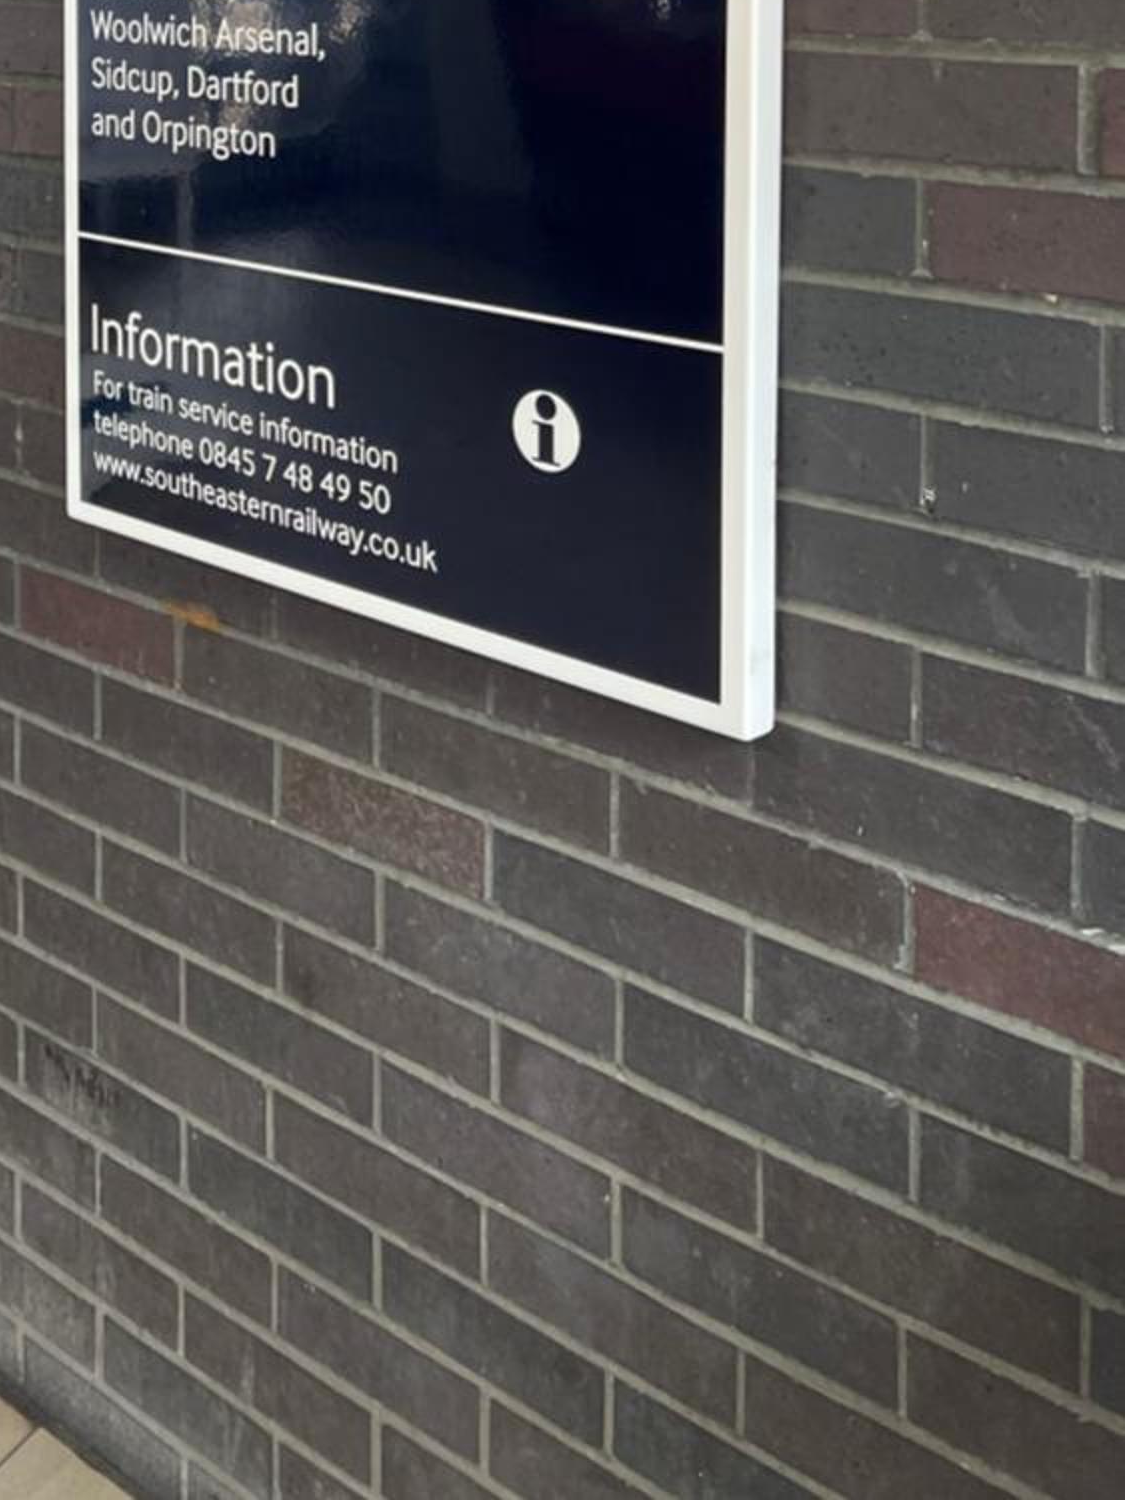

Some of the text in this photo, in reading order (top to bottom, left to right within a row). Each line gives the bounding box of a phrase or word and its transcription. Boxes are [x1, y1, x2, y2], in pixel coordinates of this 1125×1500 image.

[90, 9, 326, 62] Woolwich Arsenal,
[91, 57, 300, 108] Sidcup, Dartford
[91, 110, 276, 162] and Orpington
[91, 303, 336, 409] Information
[93, 369, 399, 475] For train service information
[93, 411, 393, 516] telephone 0845 7 48 49 50
[93, 449, 440, 575] www.southeasternrailway.co.uk
